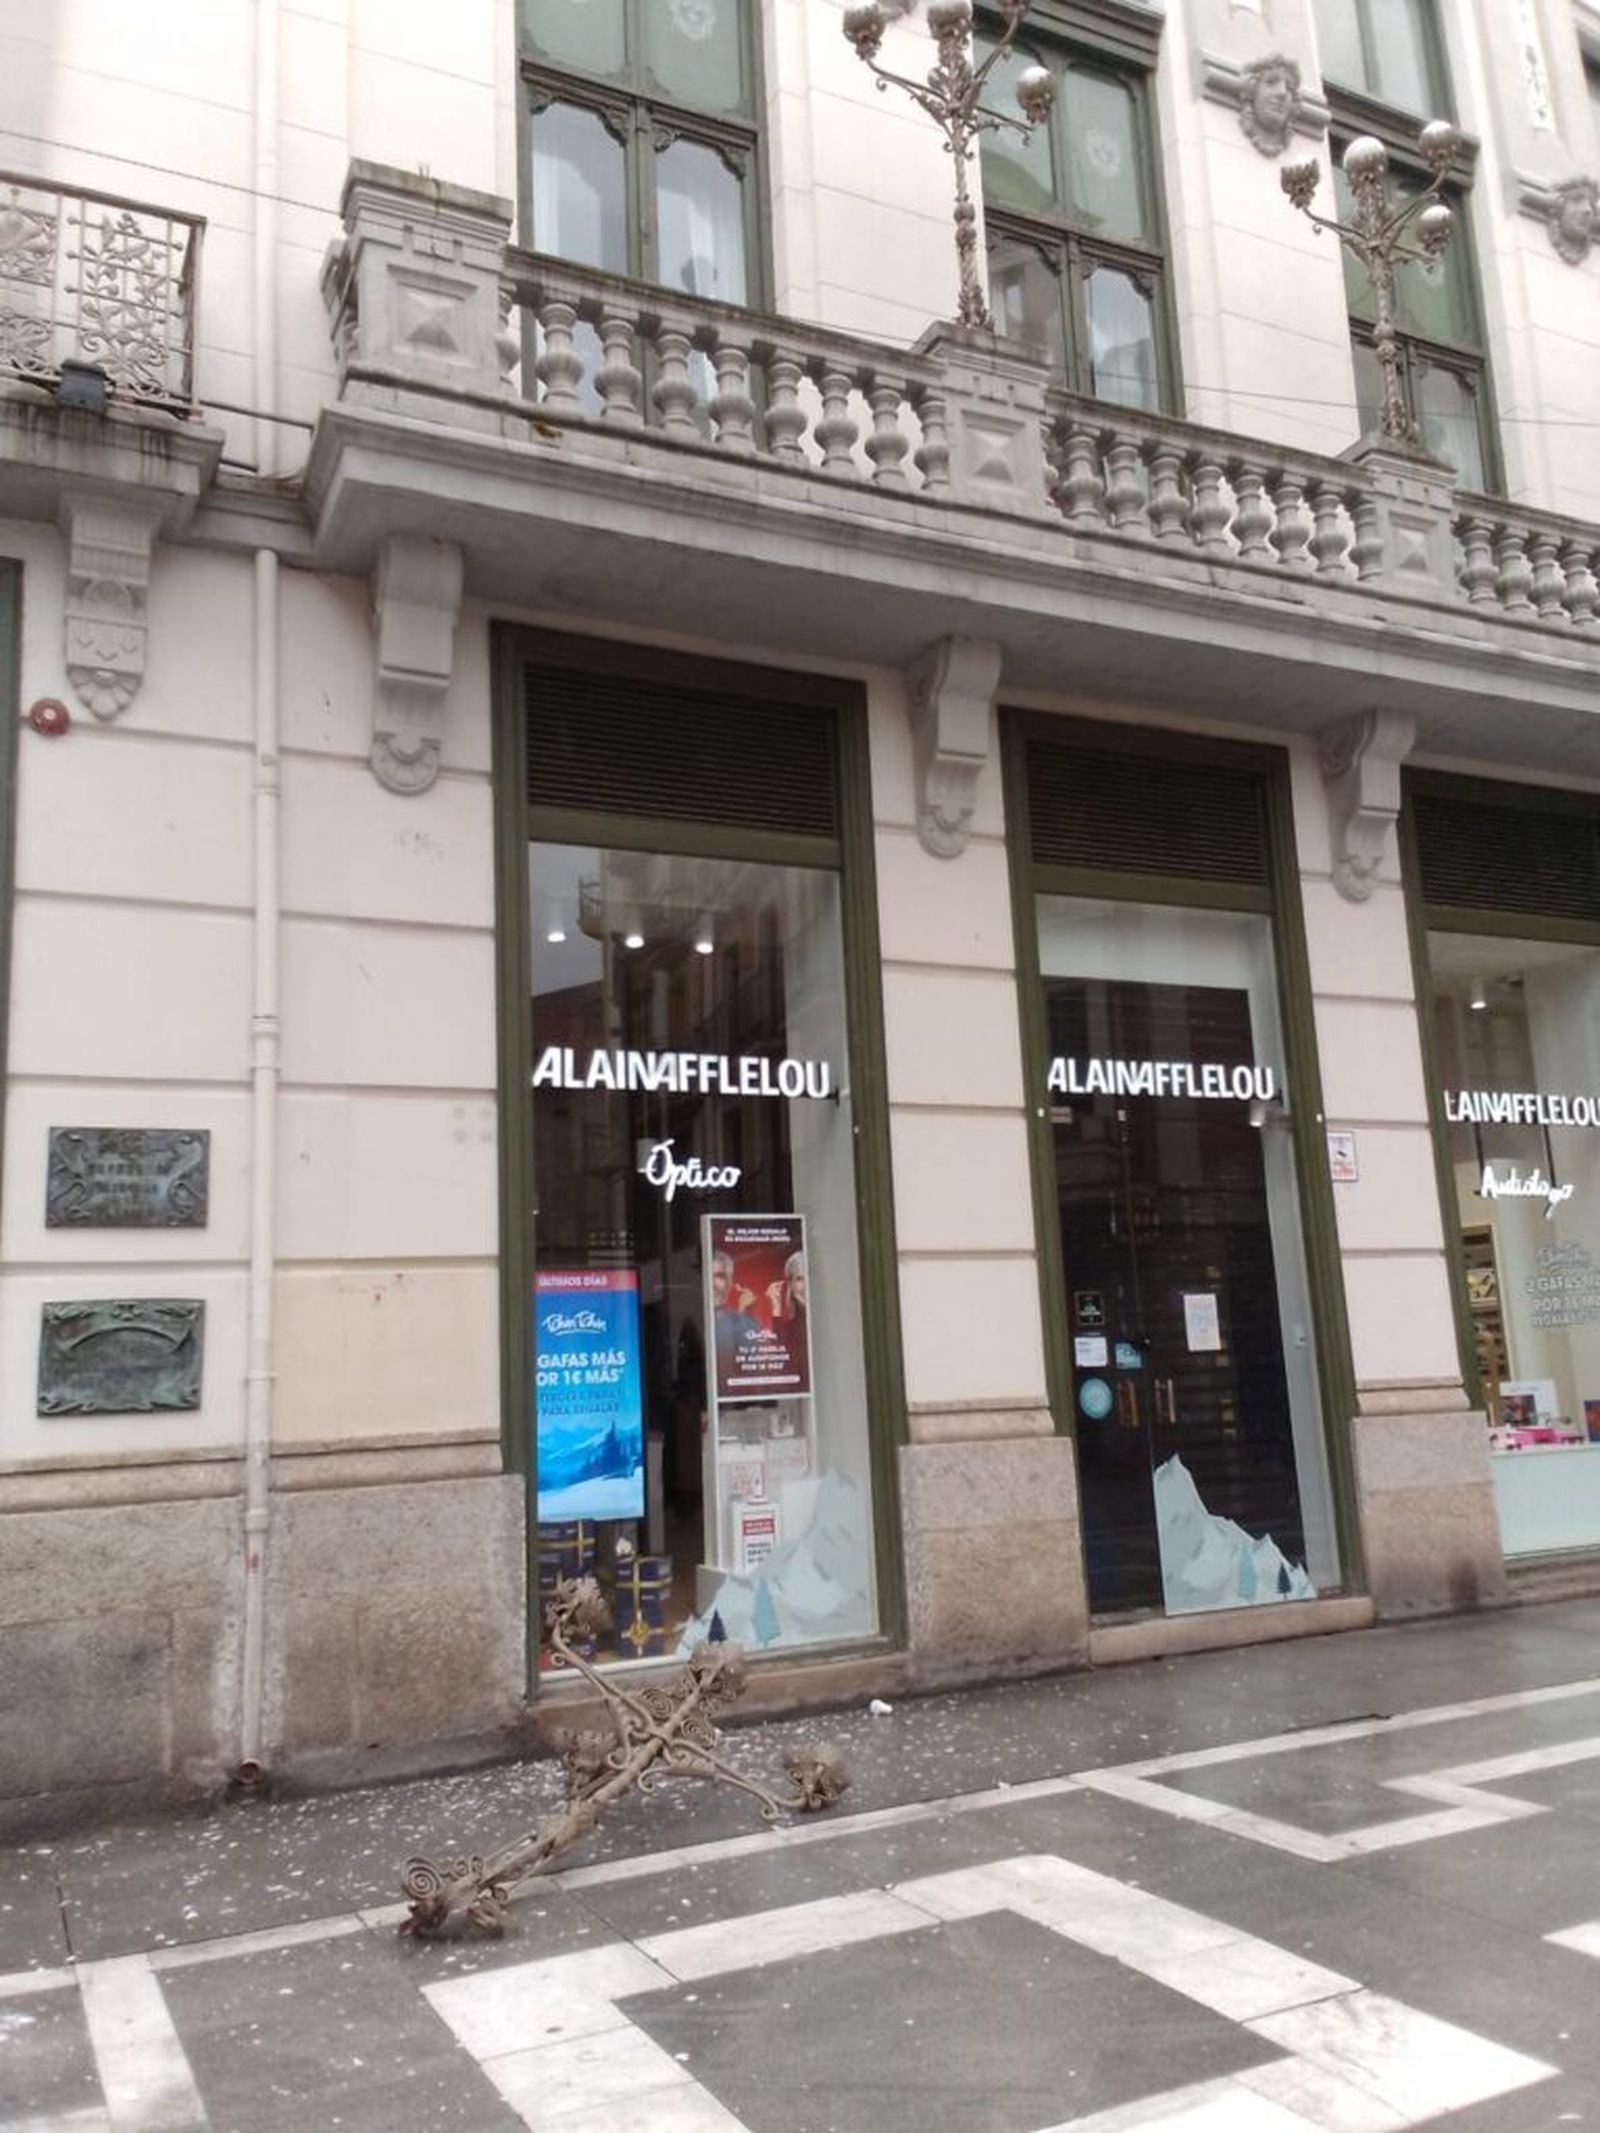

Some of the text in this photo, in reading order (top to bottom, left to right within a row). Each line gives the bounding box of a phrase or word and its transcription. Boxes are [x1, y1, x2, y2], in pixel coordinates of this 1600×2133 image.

[1444, 1090, 1600, 1126] LAINAFFLELOU
[638, 1139, 742, 1202] Óptico
[537, 1349, 626, 1368] GAFAS MÁS
[536, 1372, 558, 1387] OR
